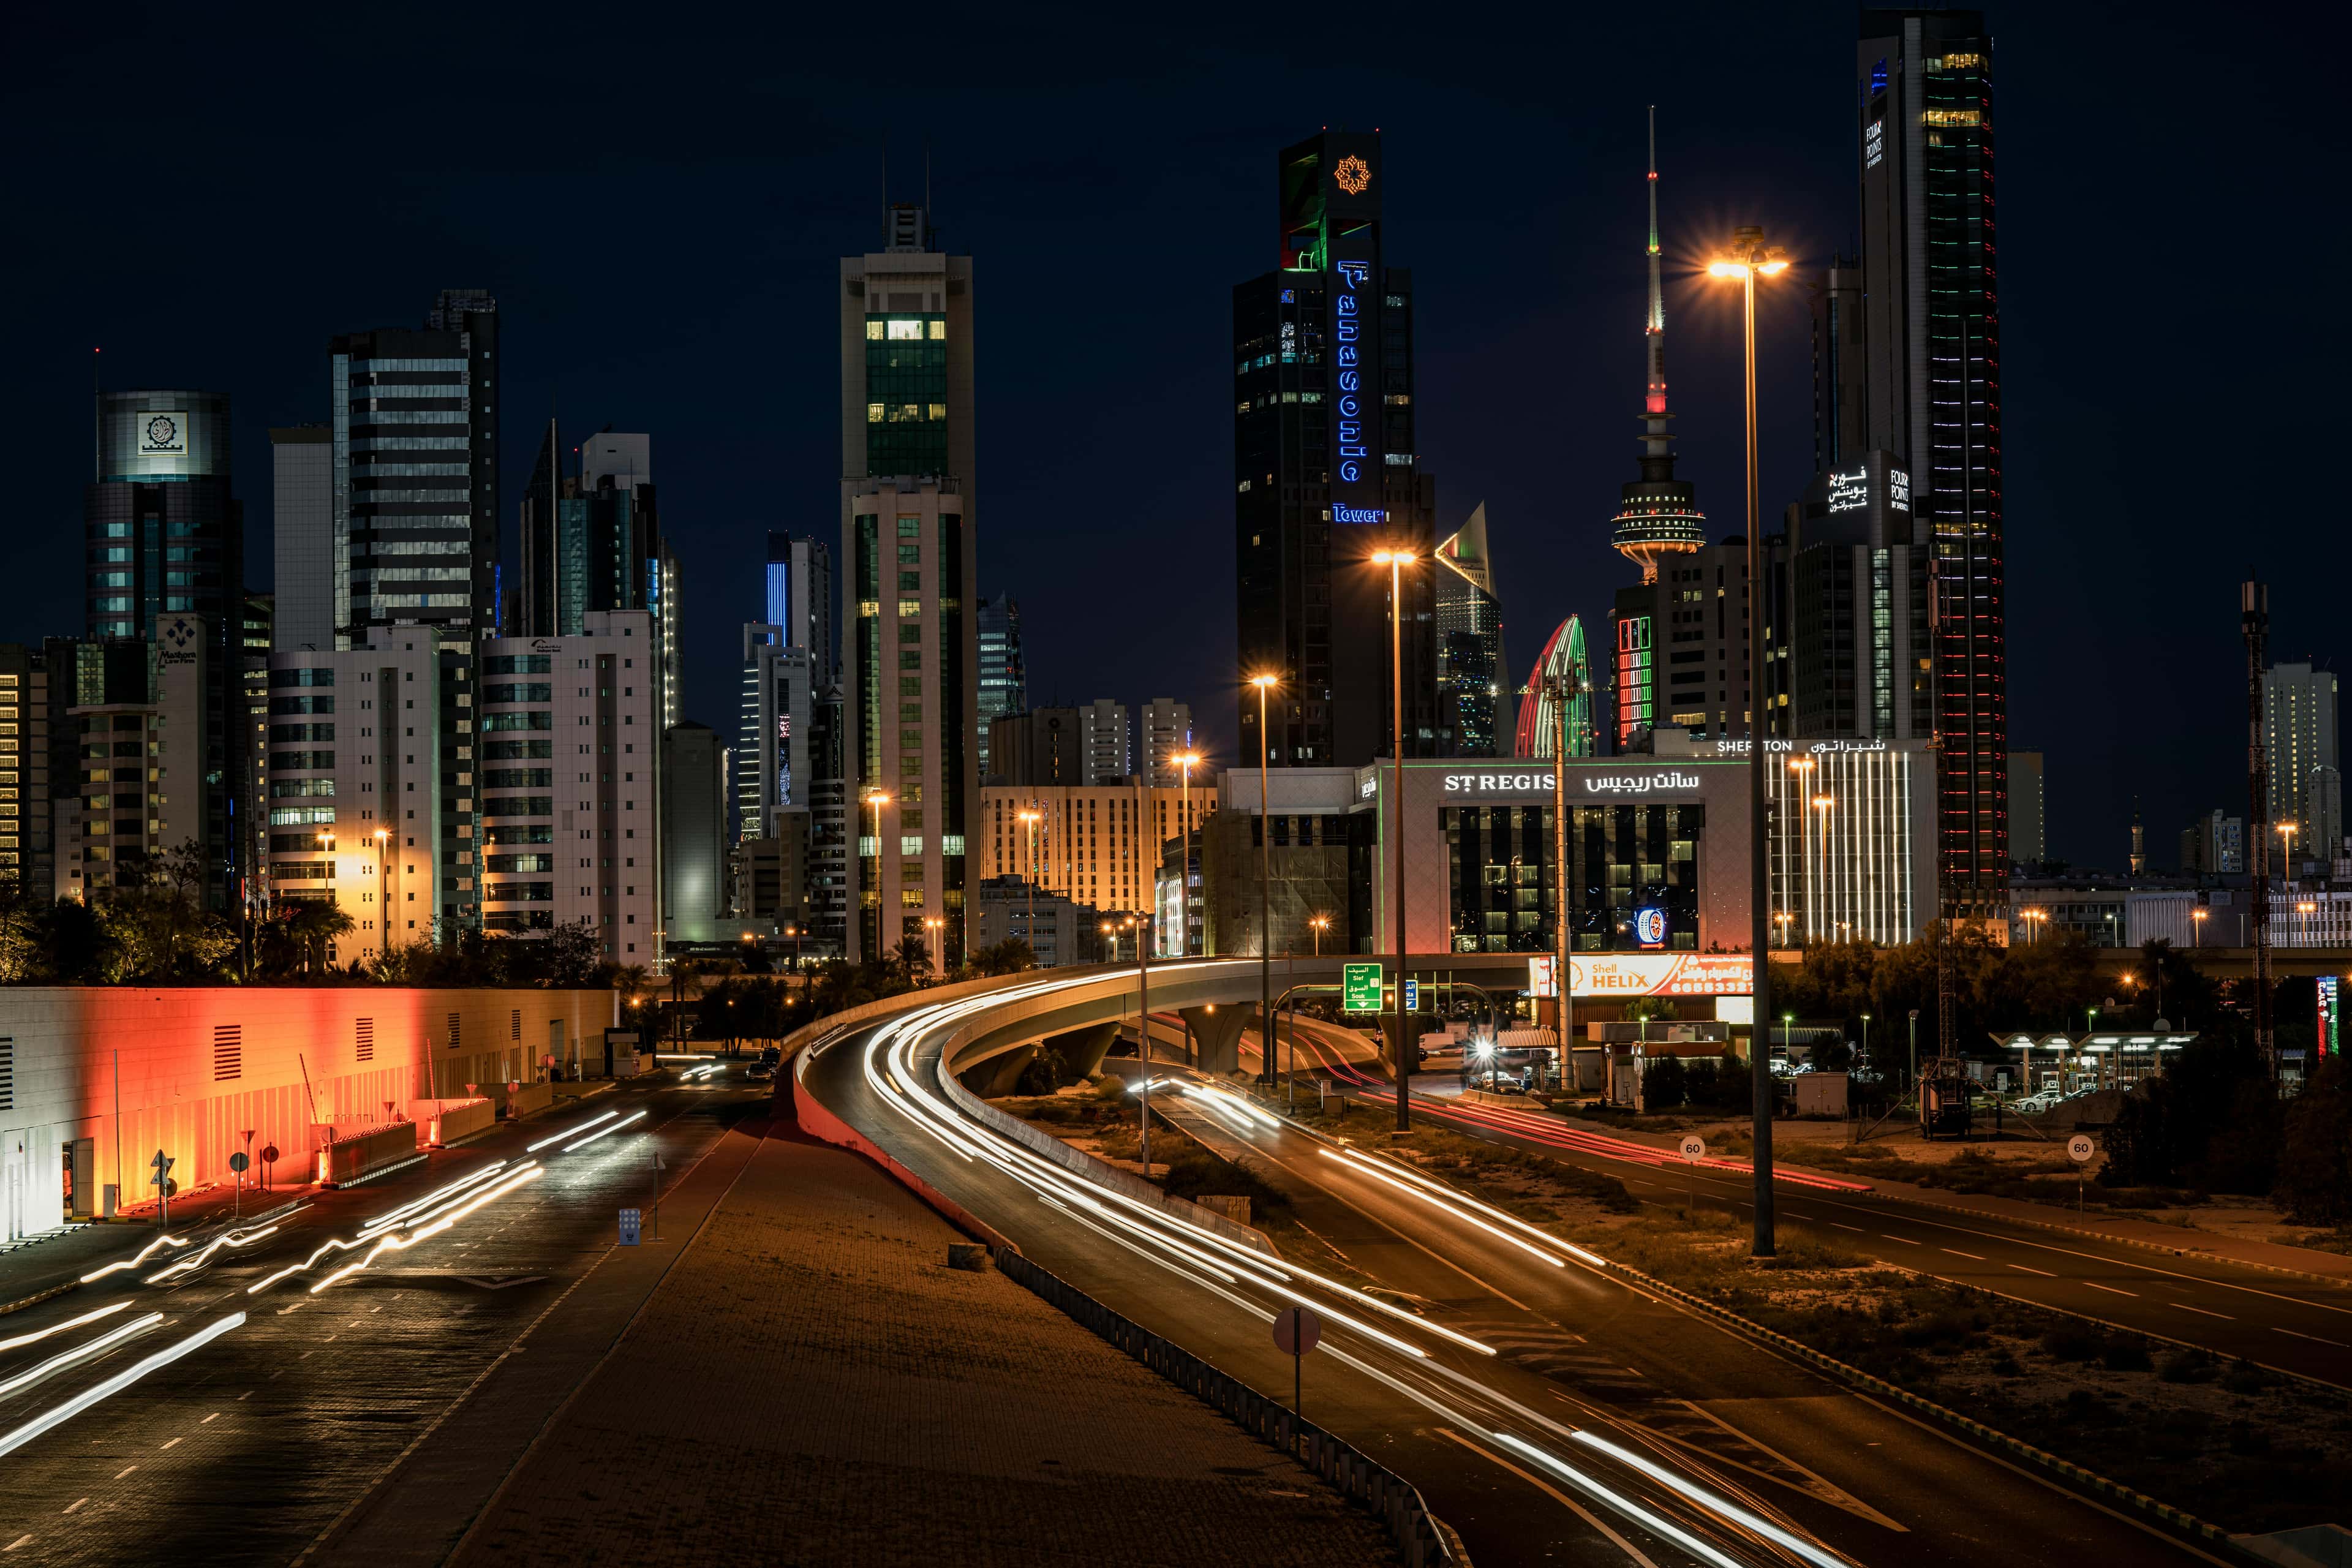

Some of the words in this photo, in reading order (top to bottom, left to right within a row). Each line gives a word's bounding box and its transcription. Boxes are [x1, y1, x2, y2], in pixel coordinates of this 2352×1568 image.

[1866, 123, 1877, 142] FOUR
[1867, 137, 1882, 159] POINTS
[1338, 261, 1368, 482] Panasonic
[1891, 470, 1905, 484] FOUR
[1828, 486, 1867, 503] بوينتس
[1891, 484, 1909, 502] POINTS
[1333, 503, 1384, 523] Tower
[1830, 498, 1867, 513] شيراتون
[1717, 741, 1792, 752] SHERTON
[1811, 739, 1885, 753] شيراتون
[1480, 774, 1555, 790] REGIS
[1585, 777, 1651, 793] ريجيس
[1653, 772, 1699, 788] سانت
[1593, 963, 1617, 973] Shell
[1593, 972, 1649, 987] HELIX
[1686, 1144, 1700, 1153] 60
[2074, 1144, 2088, 1153] 60
